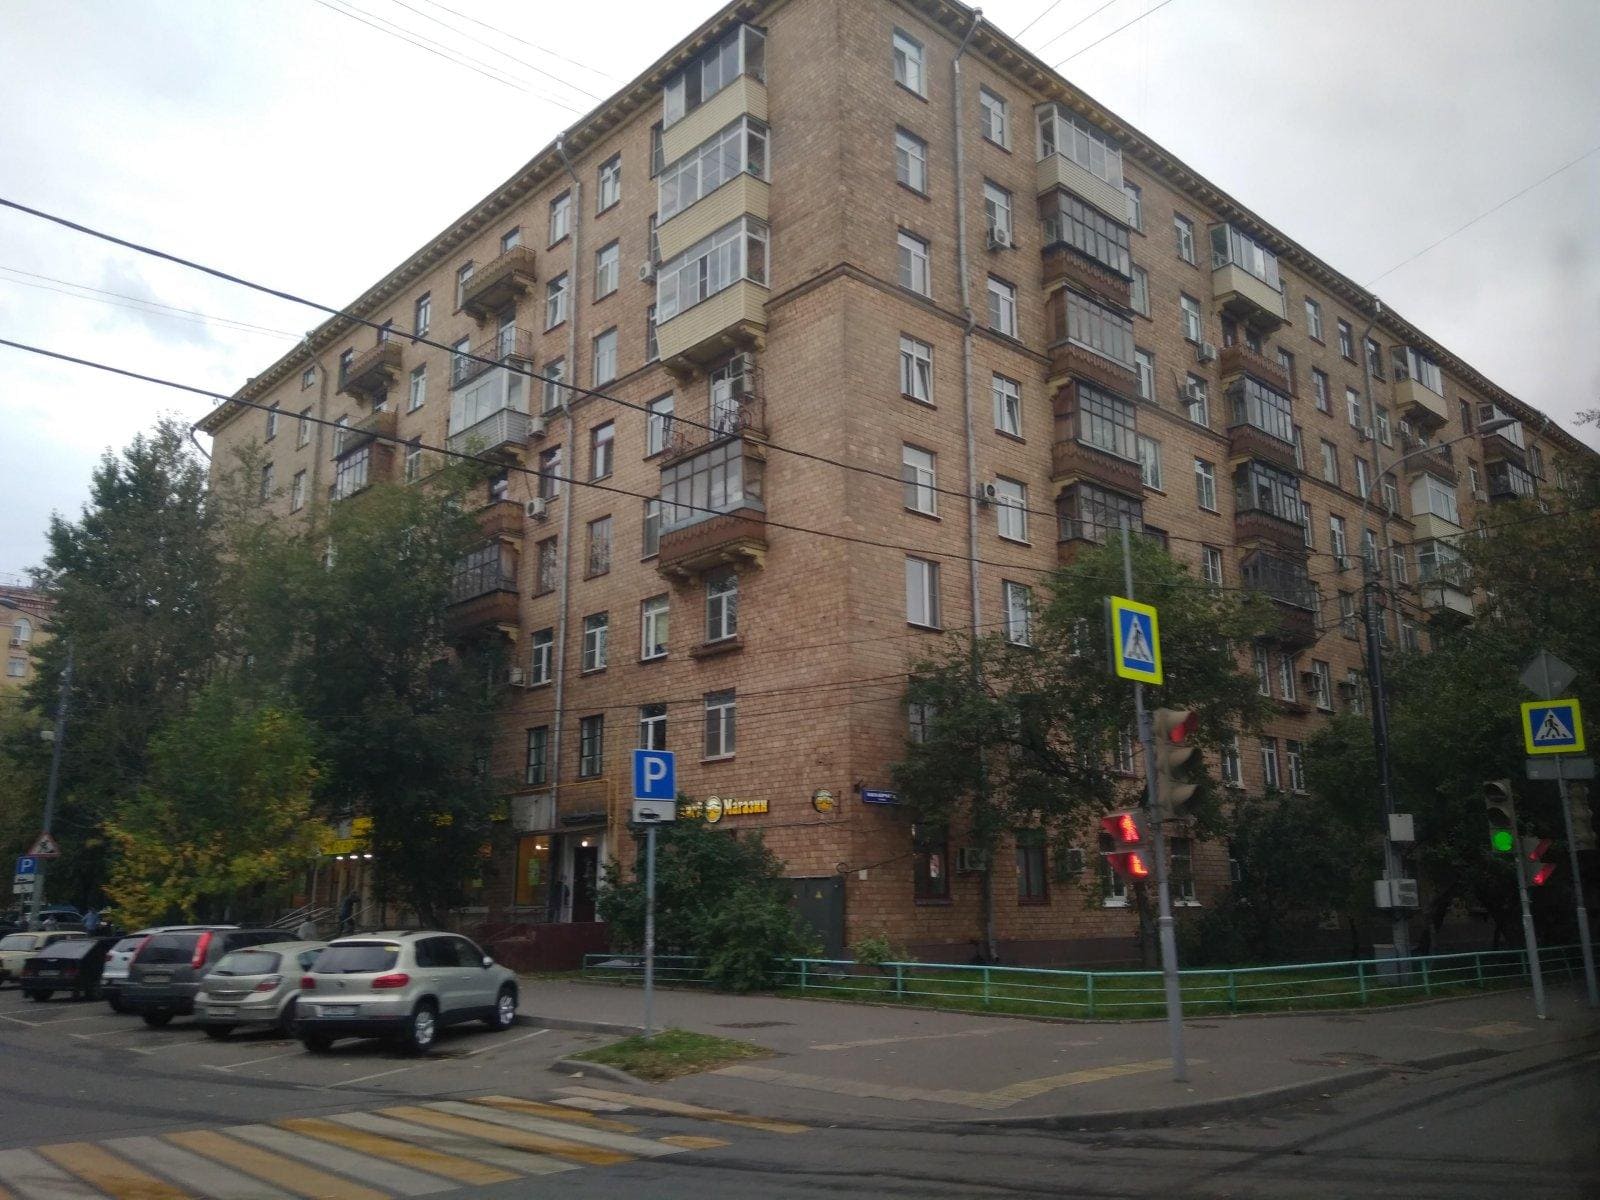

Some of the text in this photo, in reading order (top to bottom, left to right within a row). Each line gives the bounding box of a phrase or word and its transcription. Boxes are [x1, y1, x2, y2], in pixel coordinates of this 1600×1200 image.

[643, 757, 667, 792] P
[723, 799, 768, 815] Магазин
[21, 858, 33, 872] P
